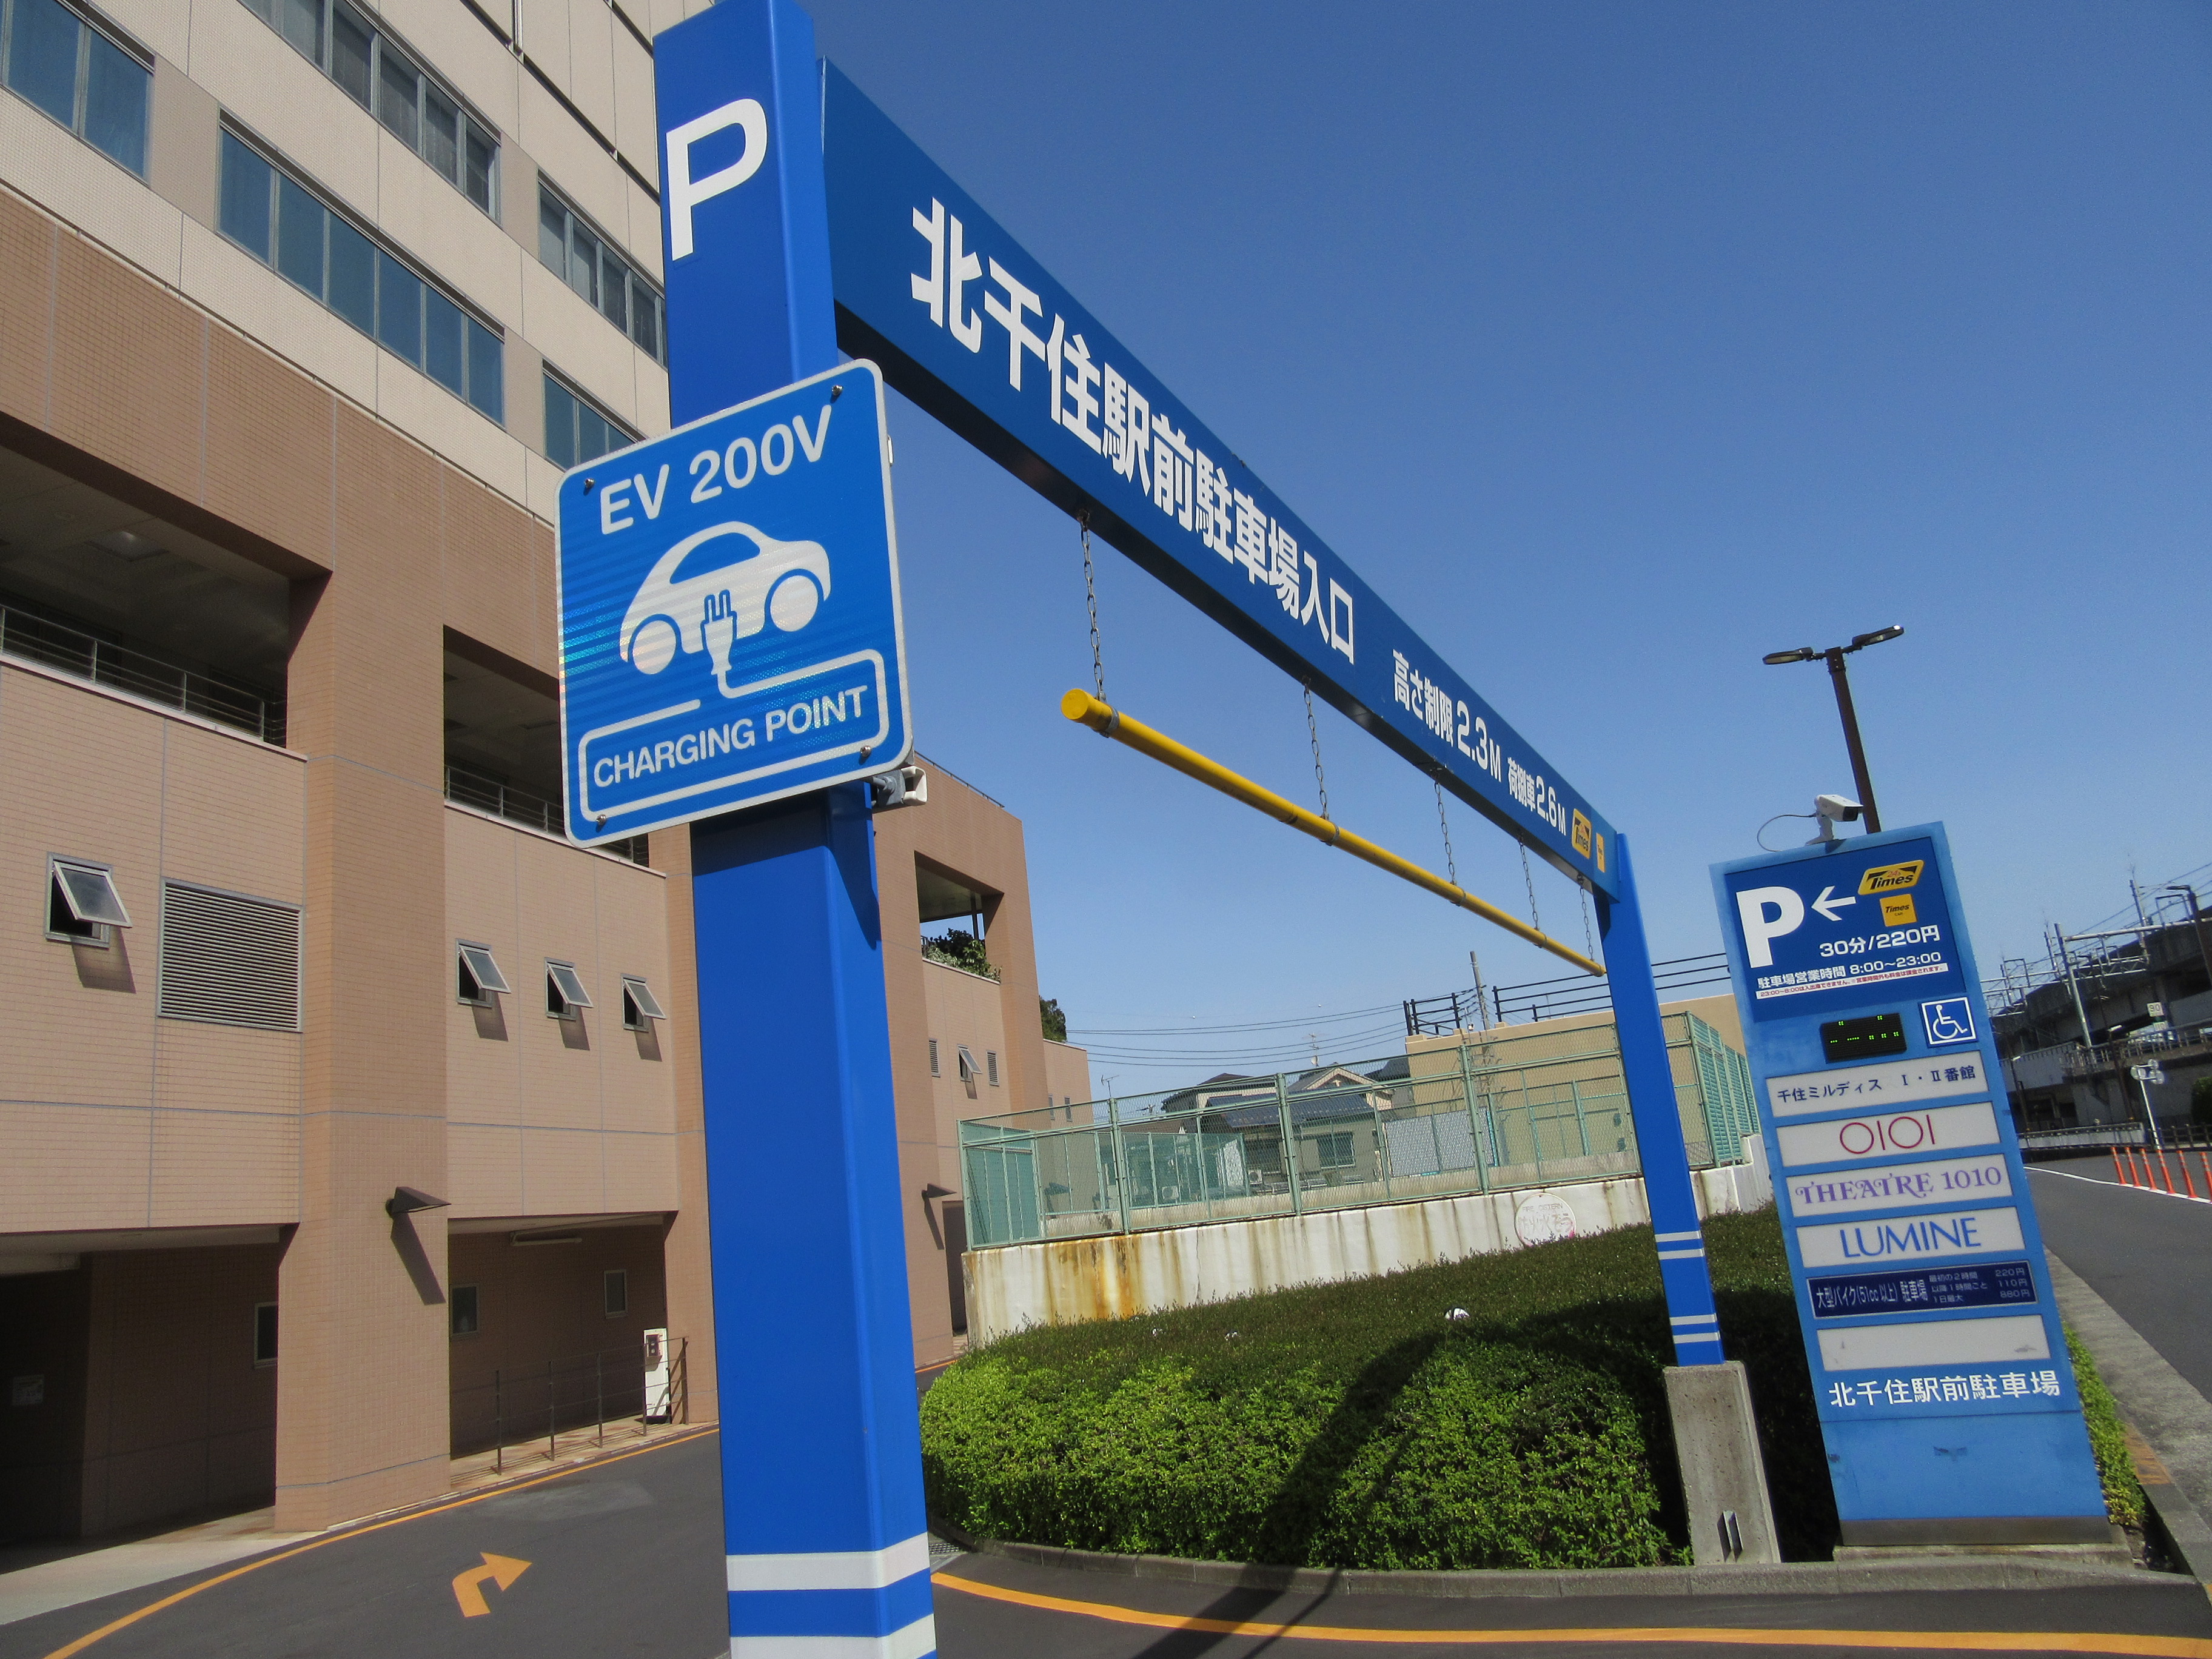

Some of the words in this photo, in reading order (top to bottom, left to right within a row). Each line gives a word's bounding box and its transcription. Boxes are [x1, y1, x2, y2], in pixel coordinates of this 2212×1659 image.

[666, 98, 768, 262] P
[910, 197, 1355, 665] 北千住駅前駐車場入口
[600, 463, 670, 535] EV
[689, 404, 832, 504] 200V
[593, 722, 755, 788] CHARGING
[766, 685, 867, 742] POINT
[1870, 874, 1914, 890] Times
[1885, 904, 1909, 913] Times
[1736, 886, 1805, 968] P
[1819, 924, 1940, 958] 30分/220円
[1757, 965, 1846, 989] 駐車場営業時間
[1777, 1078, 1882, 1104] 千住ミルディス
[1795, 1172, 1934, 1204] THEATRE
[1941, 1166, 2002, 1190] 1010
[1839, 1218, 1981, 1258] LUMINE
[1995, 1267, 2025, 1277] 220円
[1998, 1278, 2027, 1287] 110円
[1900, 1279, 1928, 1302] 駐車場
[2000, 1289, 2030, 1298] 880円
[1829, 1370, 2060, 1407] 北千住駅前駐車場
